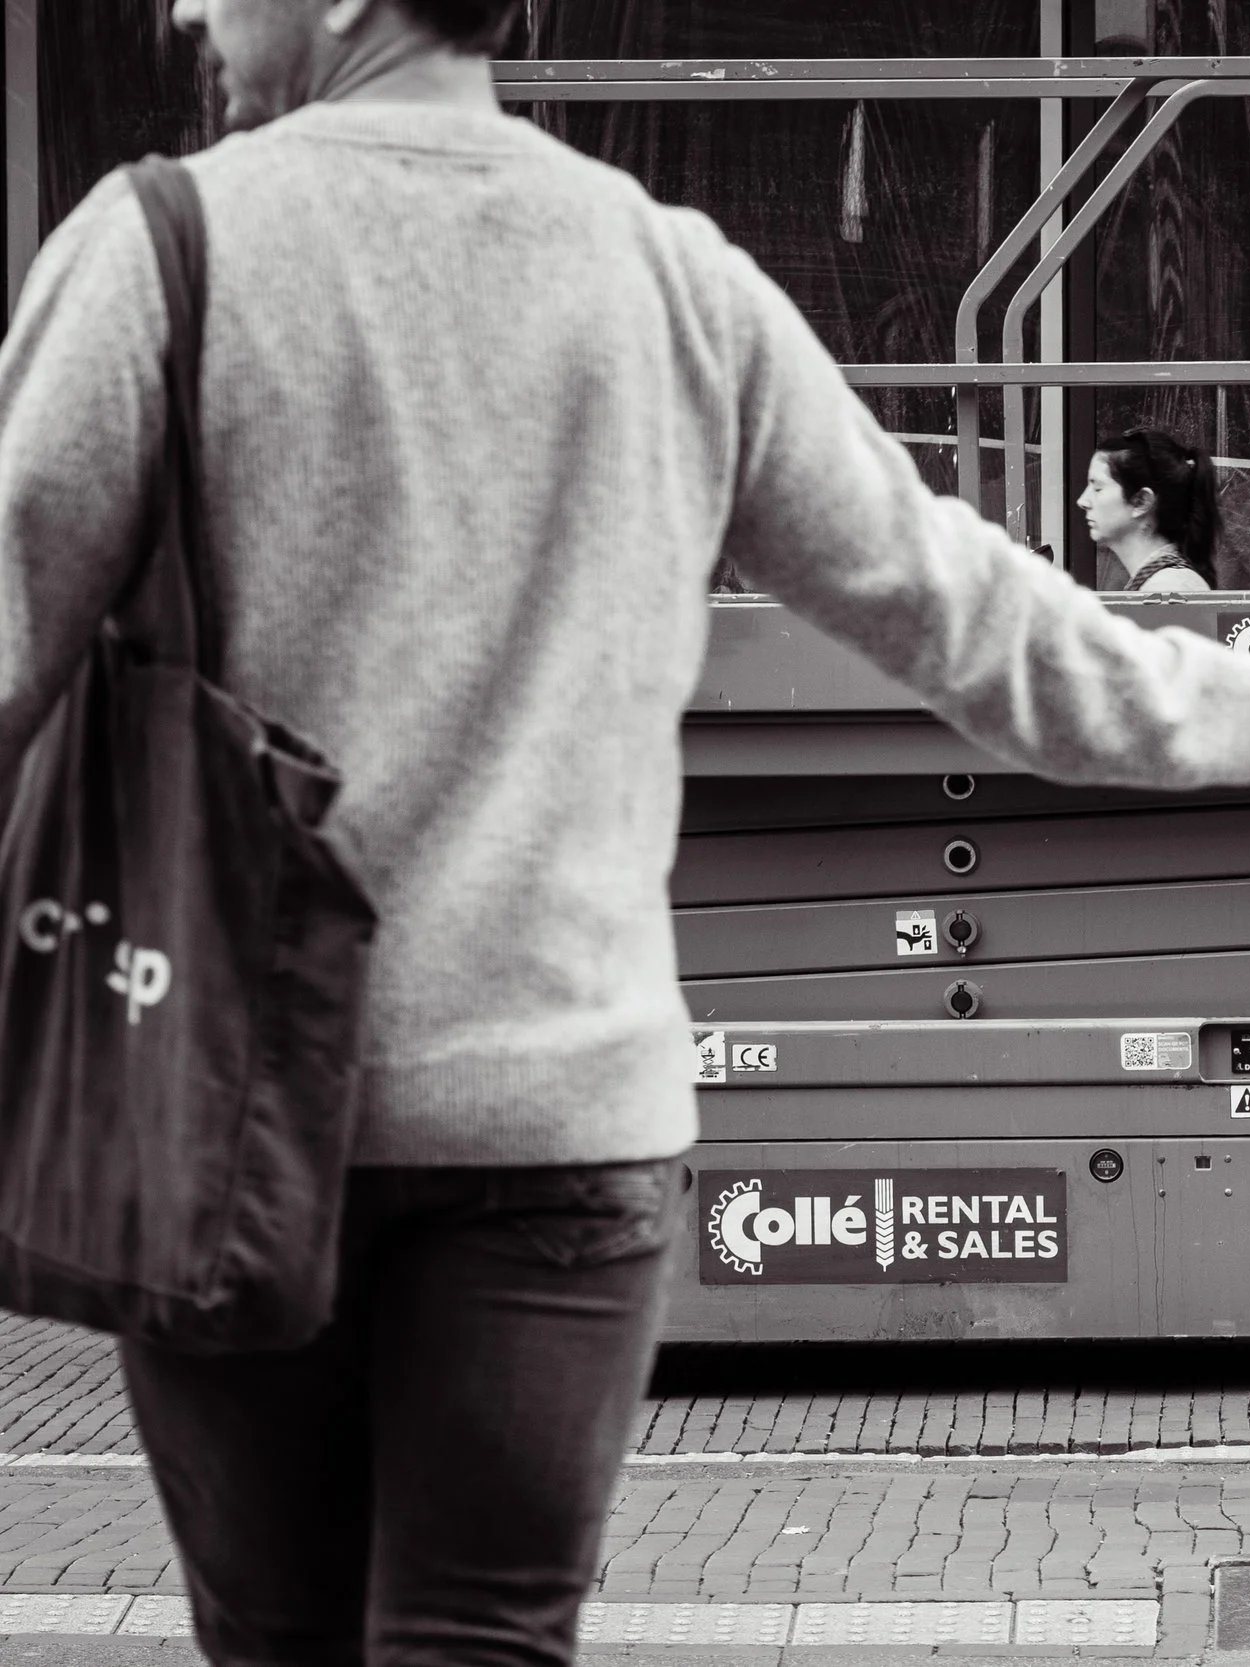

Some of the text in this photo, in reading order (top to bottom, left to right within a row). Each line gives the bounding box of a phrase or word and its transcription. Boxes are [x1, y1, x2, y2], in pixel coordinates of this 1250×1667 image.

[740, 1047, 770, 1067] CE
[902, 1195, 1057, 1225] RENTAL
[720, 1191, 867, 1263] Collé
[902, 1230, 1059, 1260] & SALES
